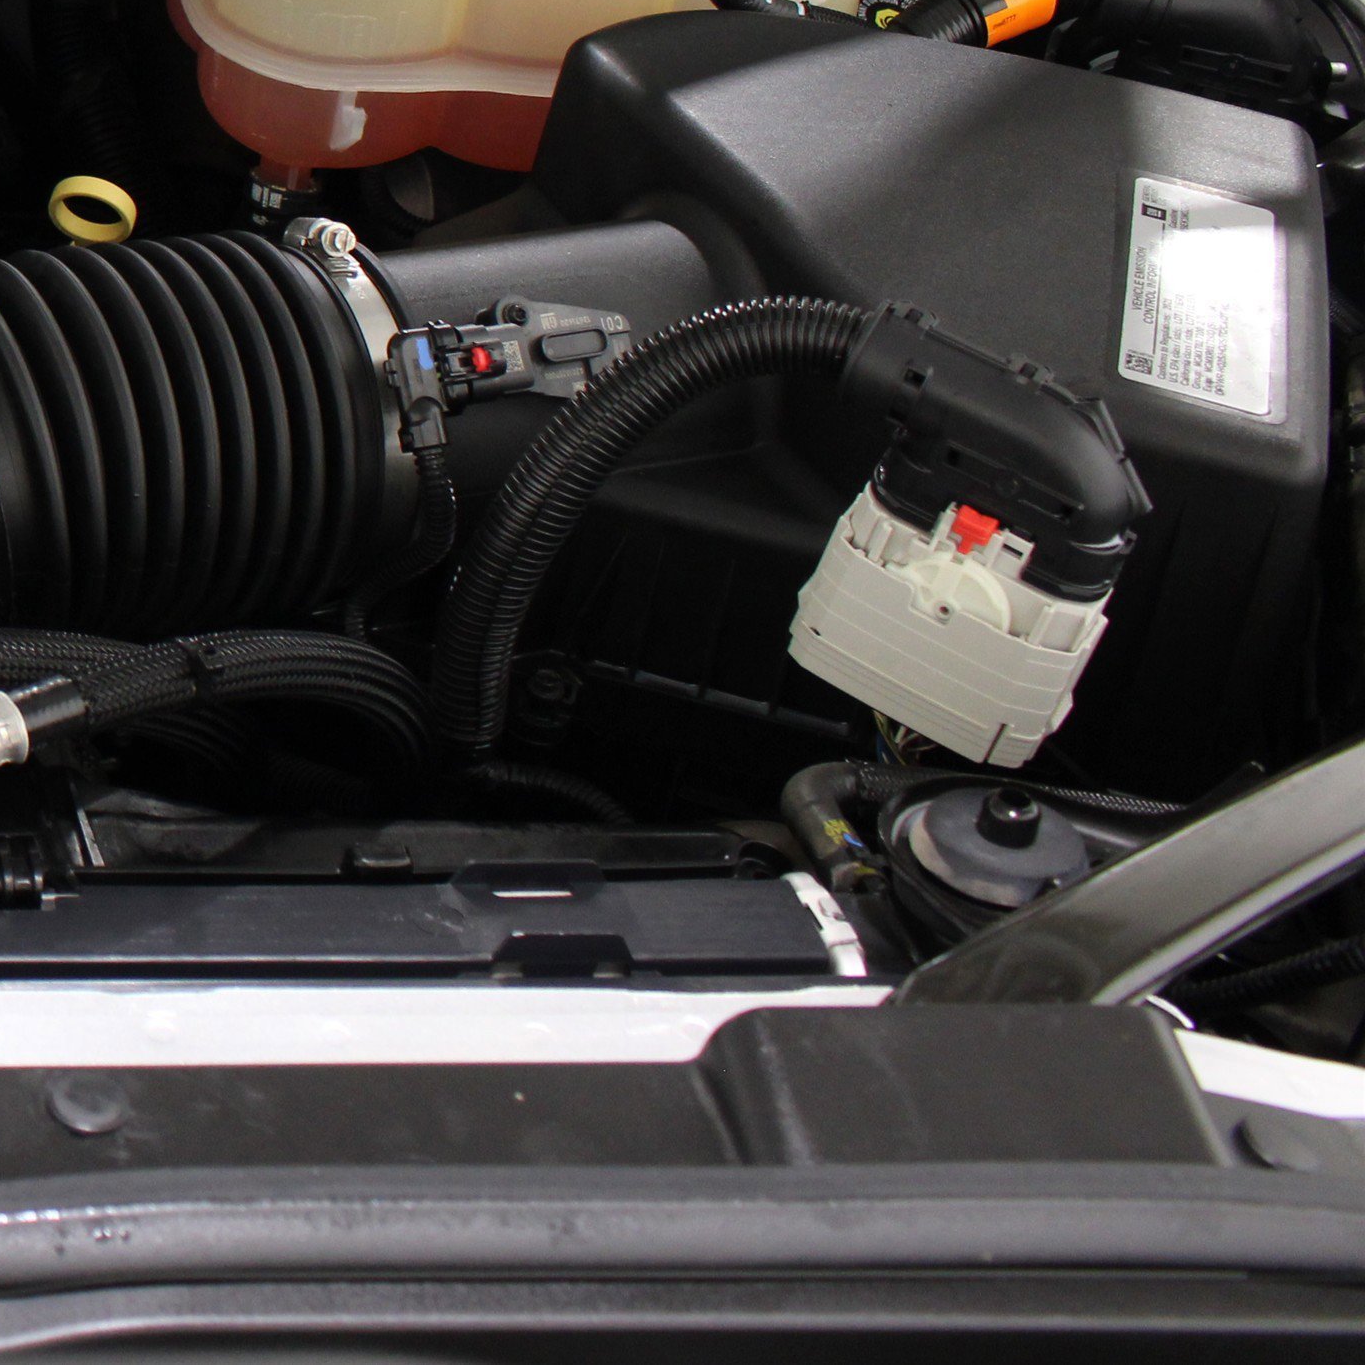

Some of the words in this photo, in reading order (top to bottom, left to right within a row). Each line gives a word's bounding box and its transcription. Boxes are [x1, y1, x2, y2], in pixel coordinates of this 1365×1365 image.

[1134, 245, 1147, 279] EMISSION
[1131, 278, 1144, 311] VEHICLE
[1142, 288, 1155, 324] CONTROL
[540, 313, 558, 330] GM
